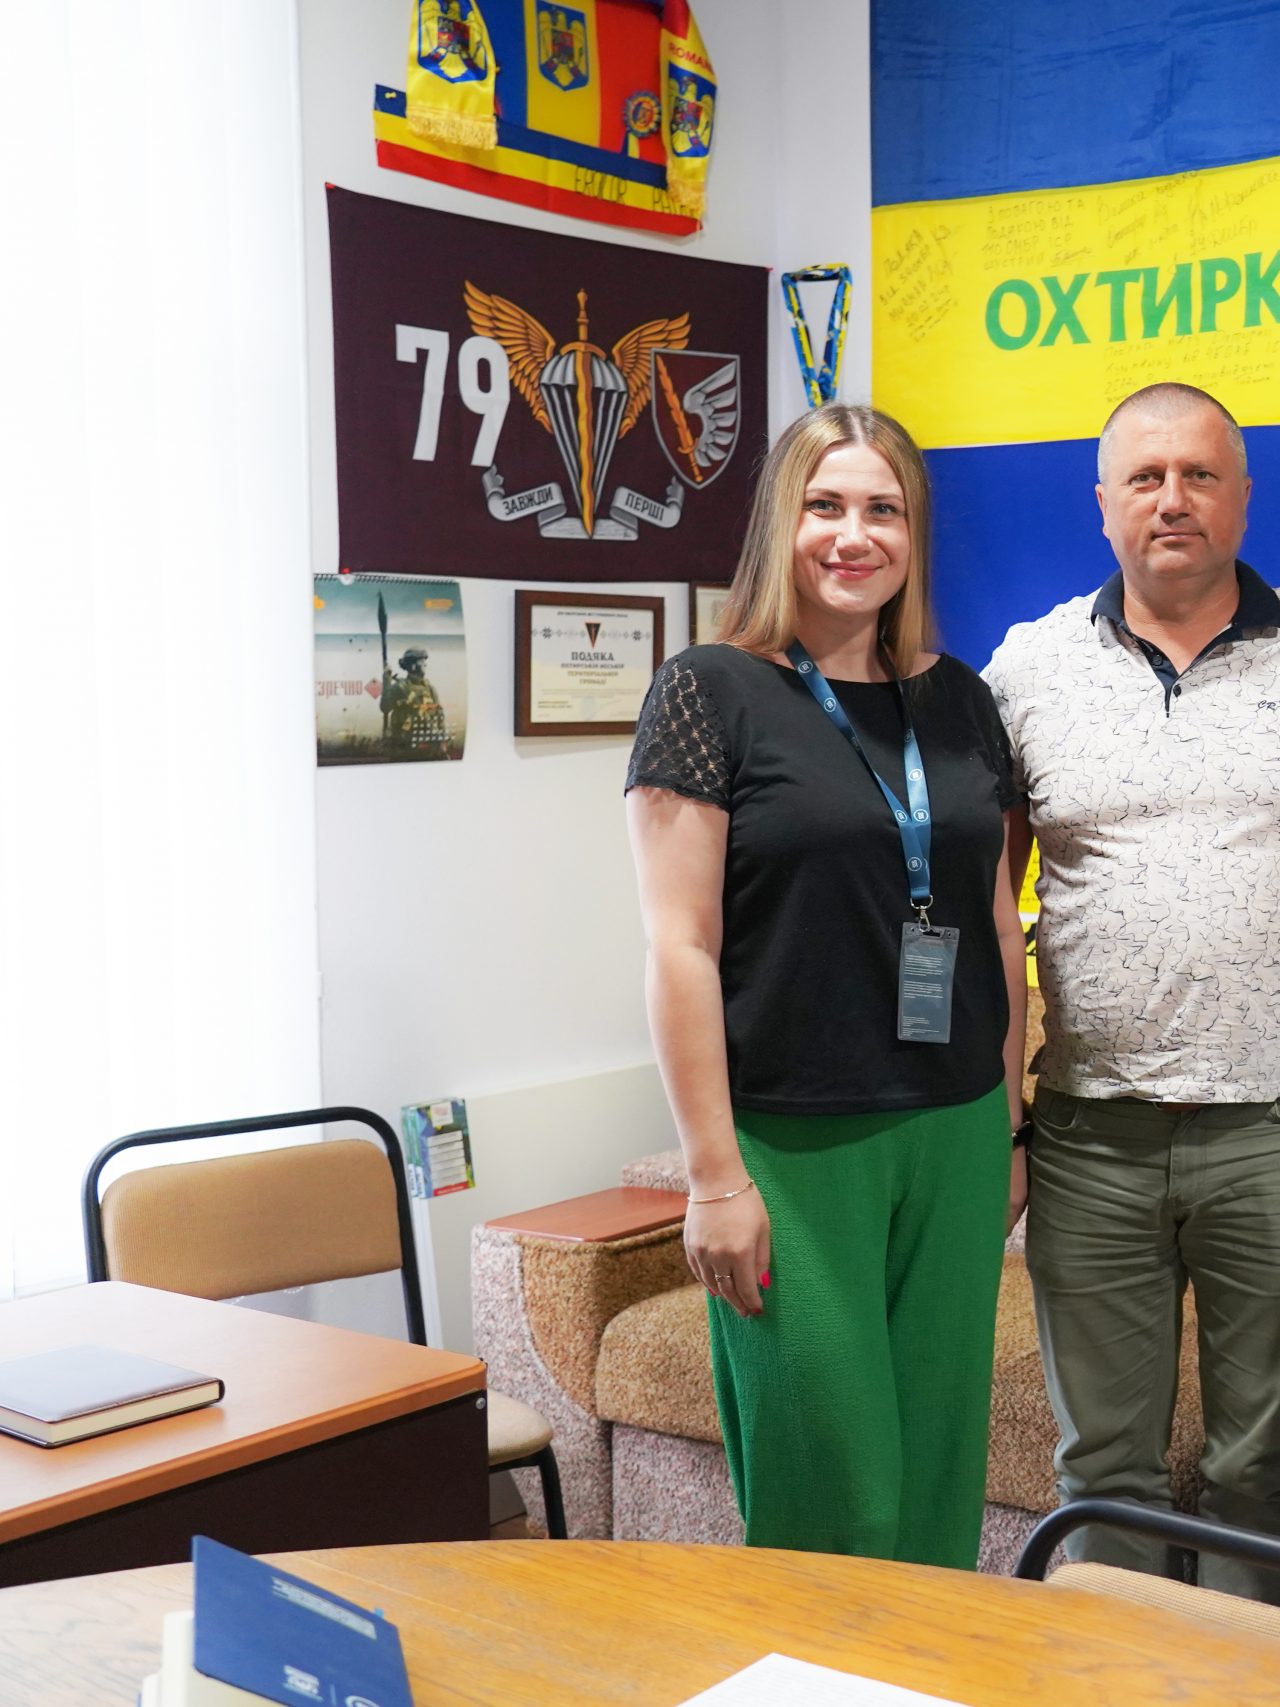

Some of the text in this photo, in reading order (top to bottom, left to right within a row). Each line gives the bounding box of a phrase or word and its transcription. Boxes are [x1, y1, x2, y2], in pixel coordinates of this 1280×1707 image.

[395, 324, 511, 468] 79
[502, 486, 554, 516] ЗАВЖДИ
[624, 492, 666, 522] ПЕРШІ
[571, 651, 615, 661] ПОДЯКА
